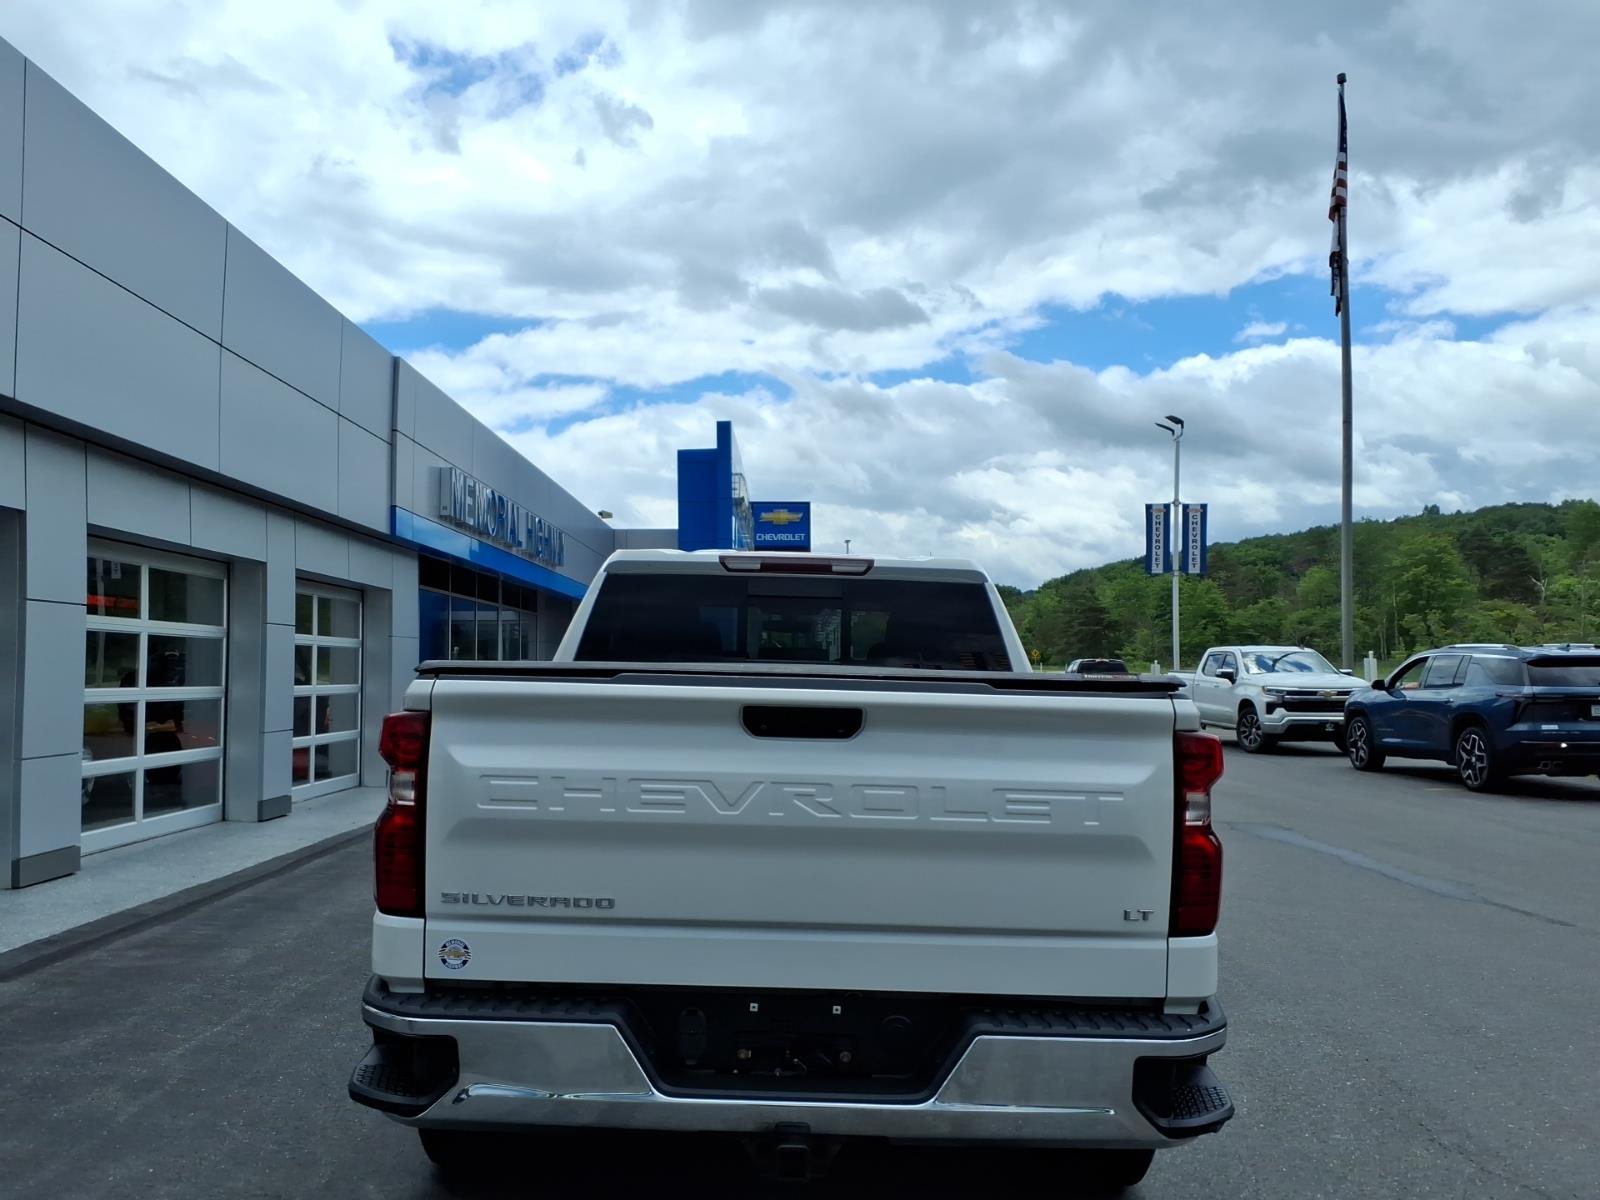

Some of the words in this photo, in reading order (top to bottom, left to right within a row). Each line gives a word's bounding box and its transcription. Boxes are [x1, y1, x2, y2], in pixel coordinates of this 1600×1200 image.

[450, 467, 523, 548] MEMORIAL
[756, 533, 805, 541] CHEVROLET
[1191, 514, 1199, 569] CHEVROLET
[477, 774, 1124, 825] CHEVROLET
[440, 891, 616, 910] SILVERADO
[1123, 909, 1156, 922] LT
